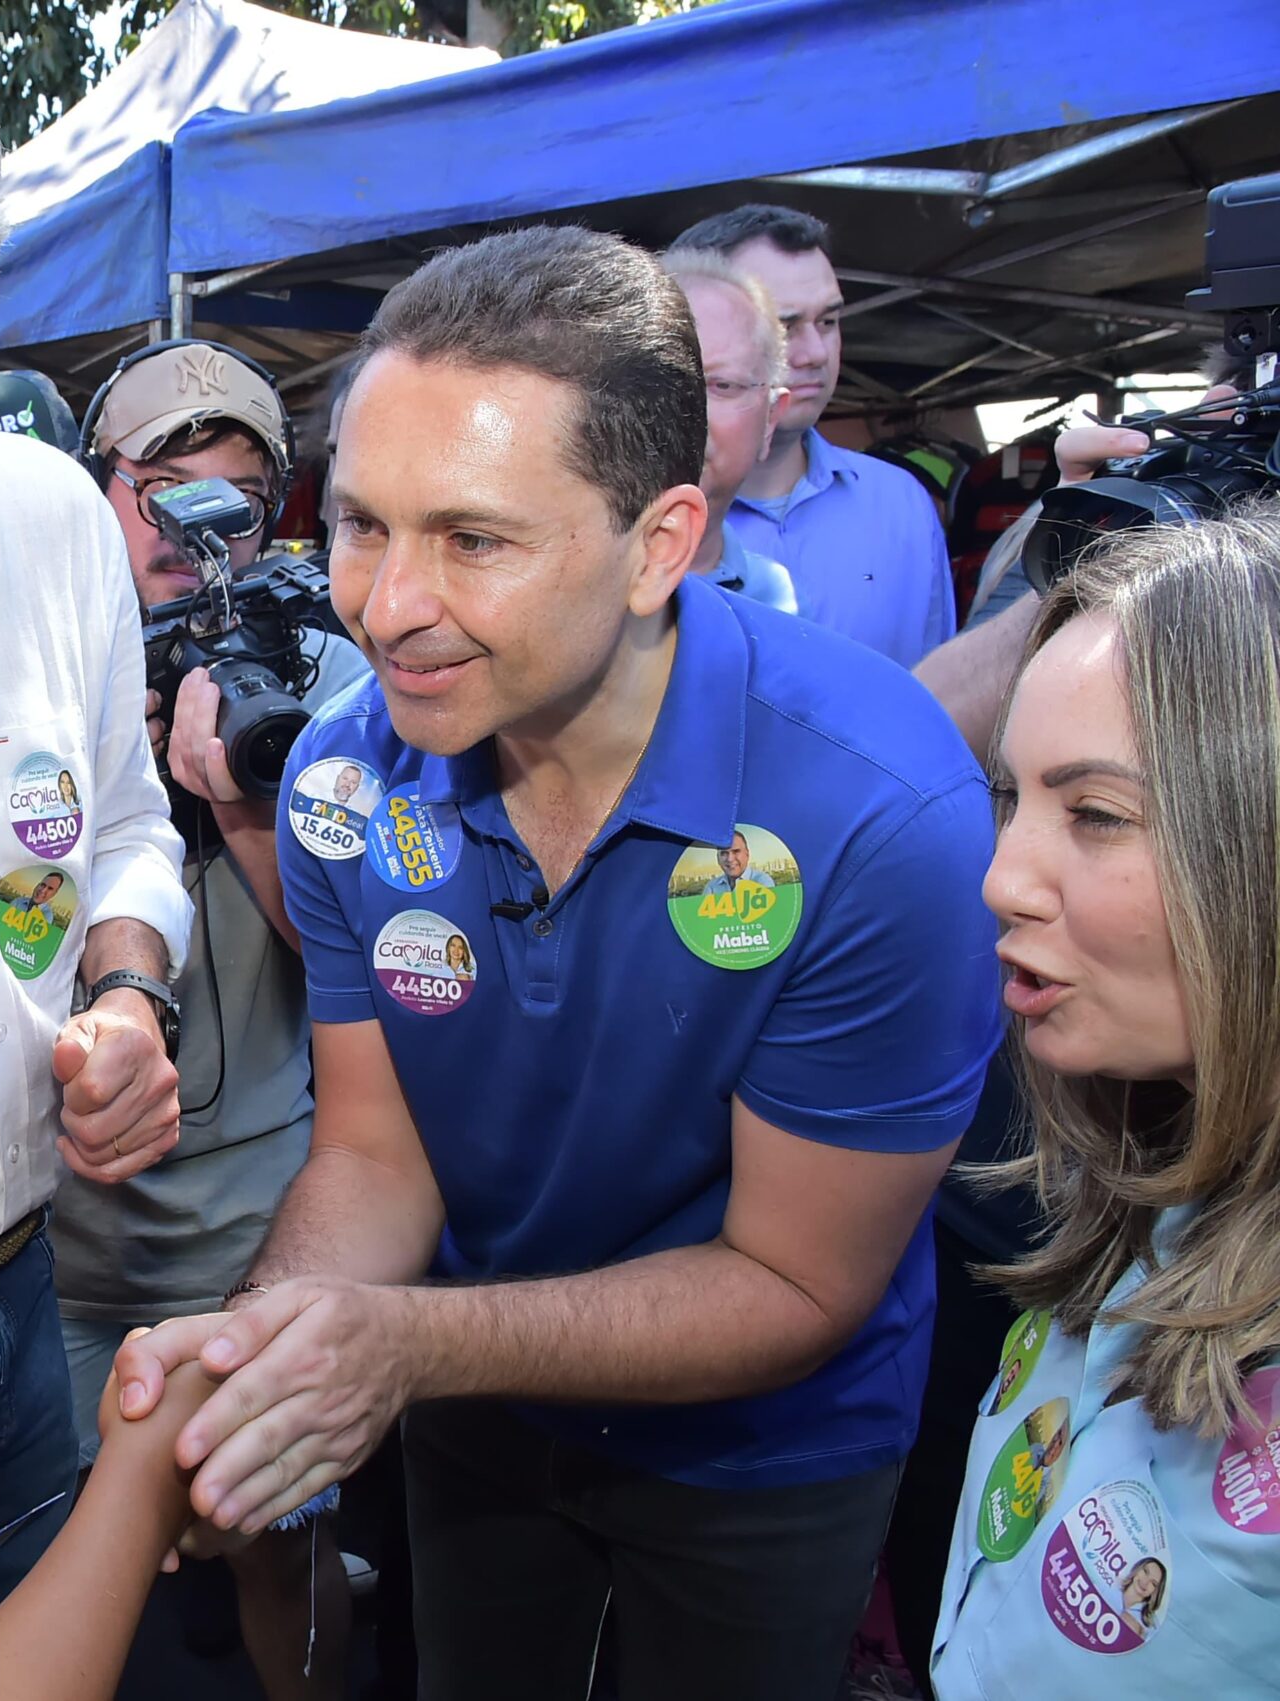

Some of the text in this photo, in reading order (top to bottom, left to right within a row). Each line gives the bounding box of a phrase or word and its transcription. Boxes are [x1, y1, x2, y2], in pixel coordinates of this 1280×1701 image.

[175, 349, 229, 396] NY
[26, 816, 78, 845] 44500
[300, 815, 354, 849] 15.650
[388, 797, 434, 887] 44555
[422, 828, 444, 879] Teixeira
[1, 905, 27, 933] 44
[697, 887, 768, 920] 44 Já
[4, 940, 36, 965] Mabel
[713, 929, 770, 949] Mabel
[392, 975, 462, 1000] 44500
[1219, 1450, 1268, 1527] 44044
[990, 1486, 1008, 1542] Mabel
[1093, 1558, 1116, 1588] Rosa
[1048, 1547, 1121, 1645] 44500
